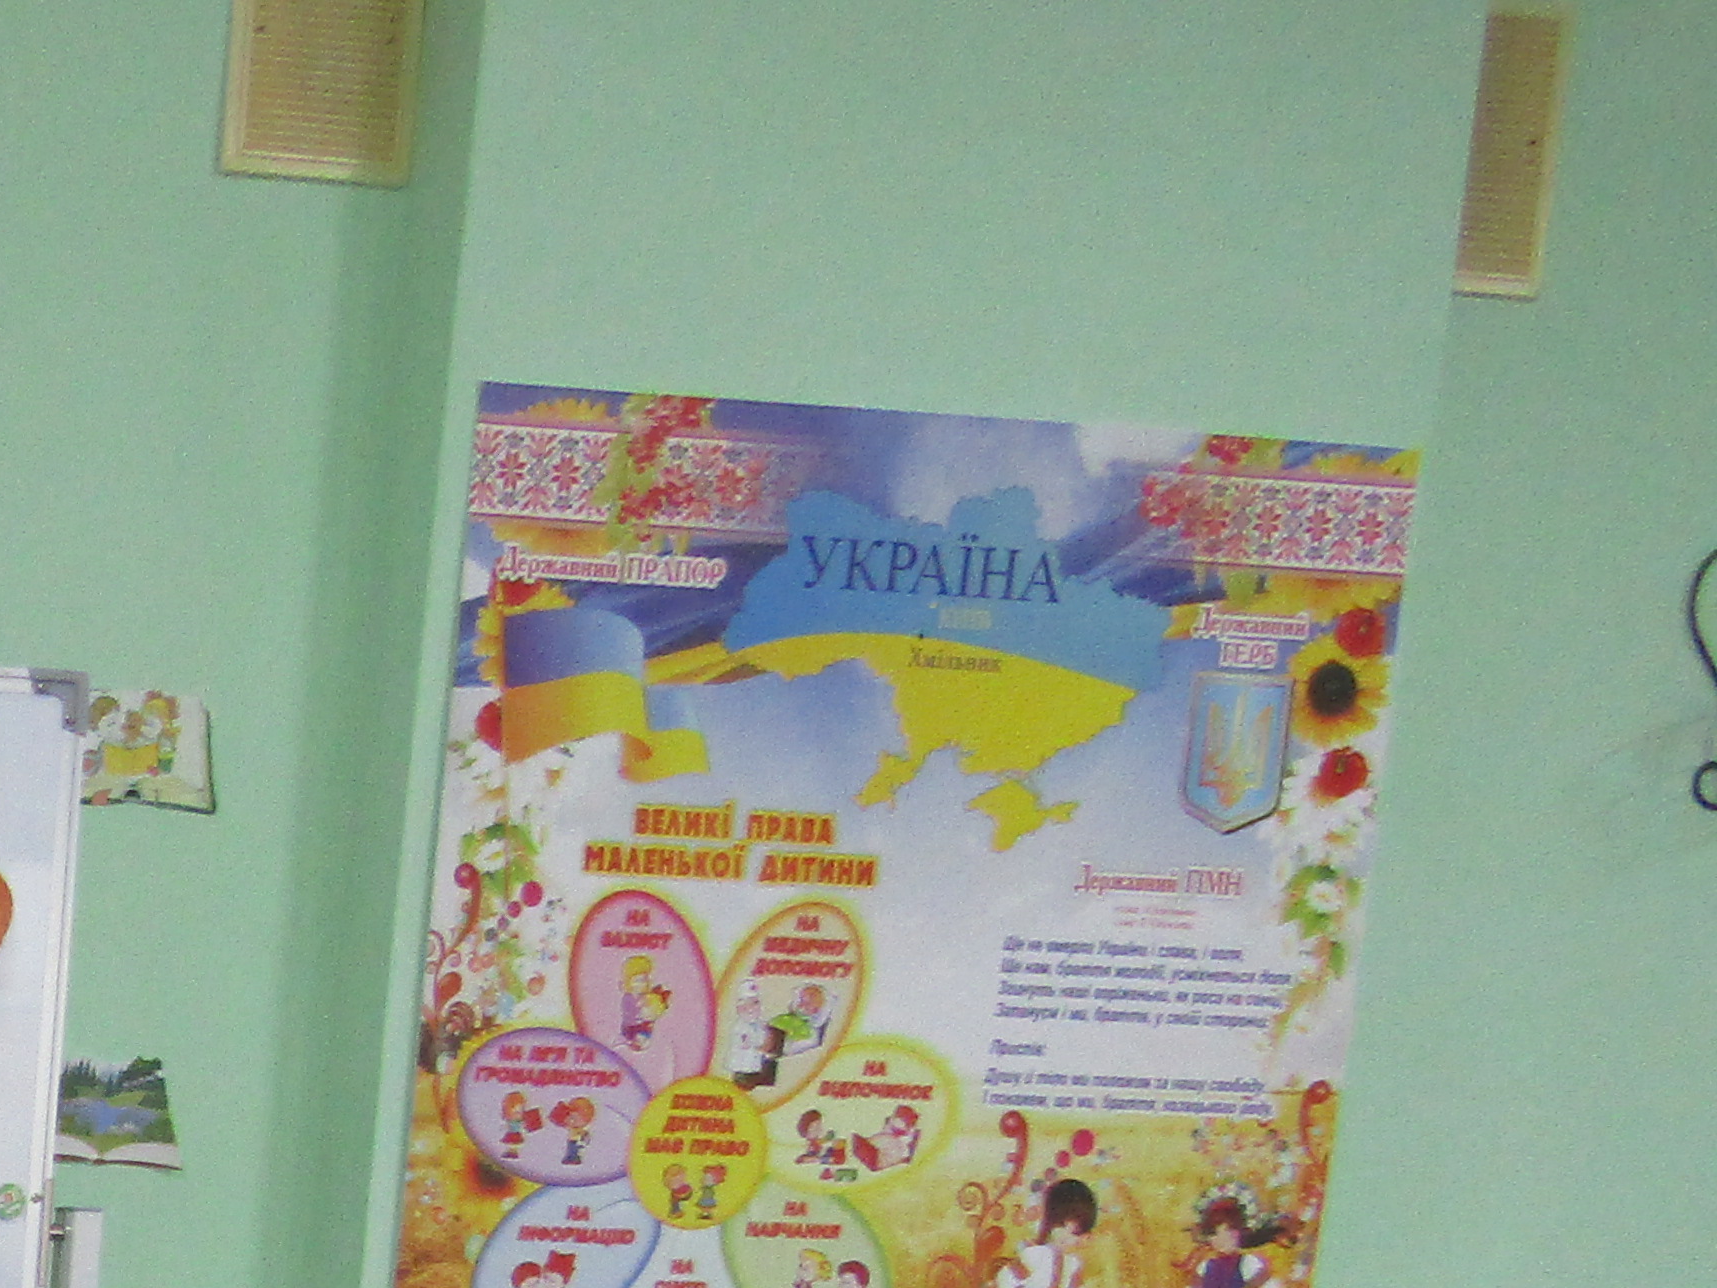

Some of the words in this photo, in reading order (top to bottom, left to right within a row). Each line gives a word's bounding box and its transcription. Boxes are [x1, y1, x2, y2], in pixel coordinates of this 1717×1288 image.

[624, 555, 727, 588] ПРАПОР
[802, 533, 1059, 603] УКРАЇНА
[1221, 640, 1277, 668] ГЕРБ
[634, 802, 733, 838] ВЕЛИКІ
[748, 813, 834, 844] ПРАВА
[584, 843, 746, 878] МАЛЕНЬКОЇ
[758, 855, 876, 885] ДИТИНИ
